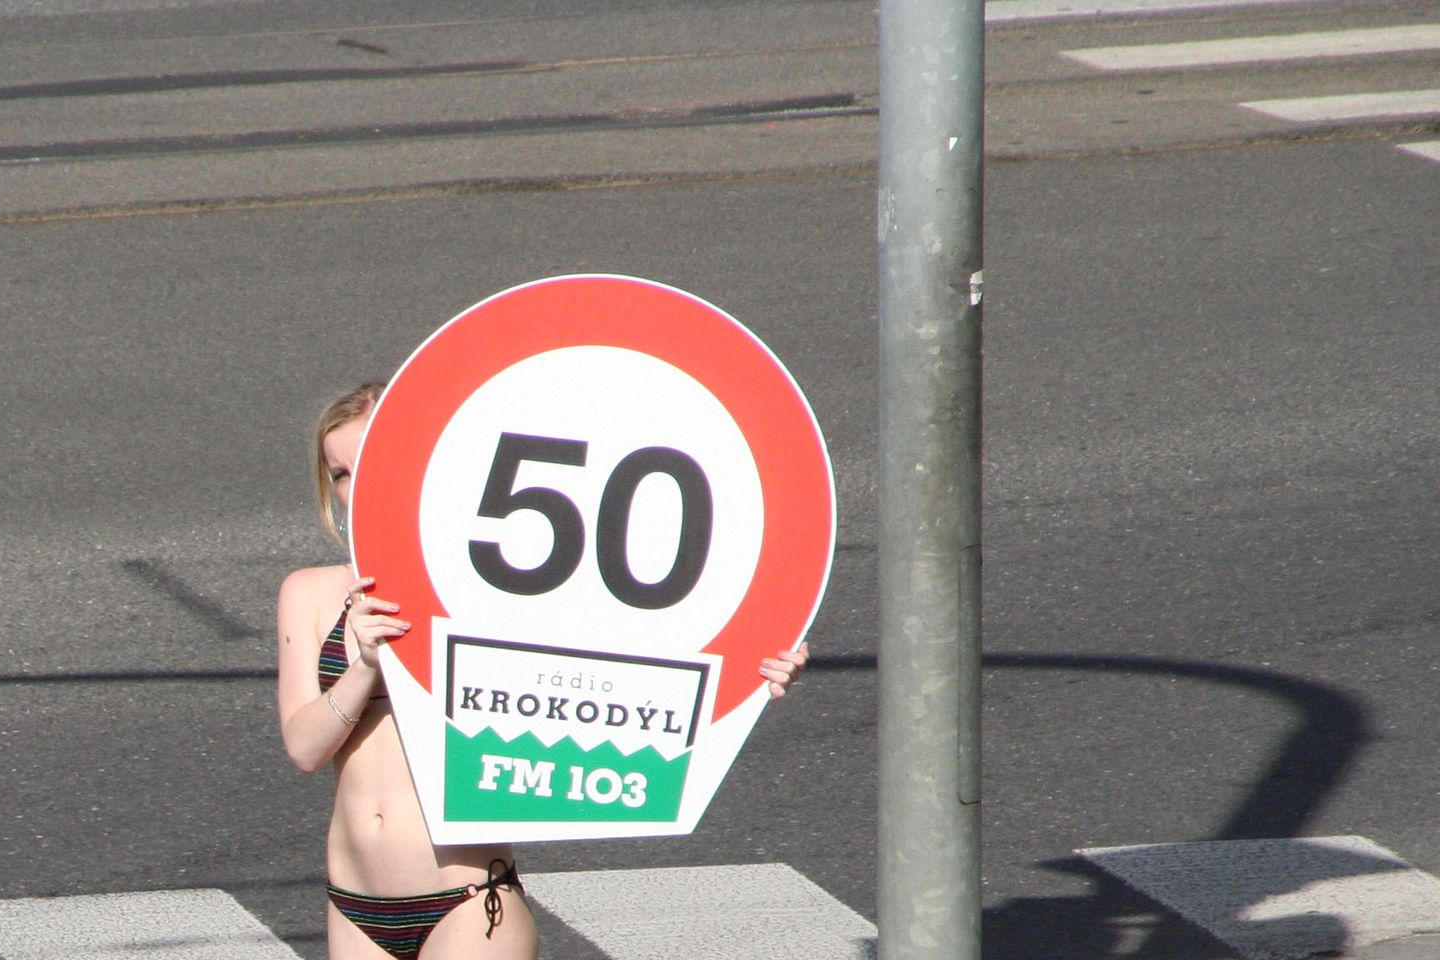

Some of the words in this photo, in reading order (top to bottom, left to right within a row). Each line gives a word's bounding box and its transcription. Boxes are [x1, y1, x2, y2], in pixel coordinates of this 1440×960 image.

[468, 431, 714, 610] 50
[536, 670, 614, 693] rádio
[460, 686, 682, 734] KROKODÝL
[478, 754, 556, 798] FM
[567, 766, 648, 808] 103
